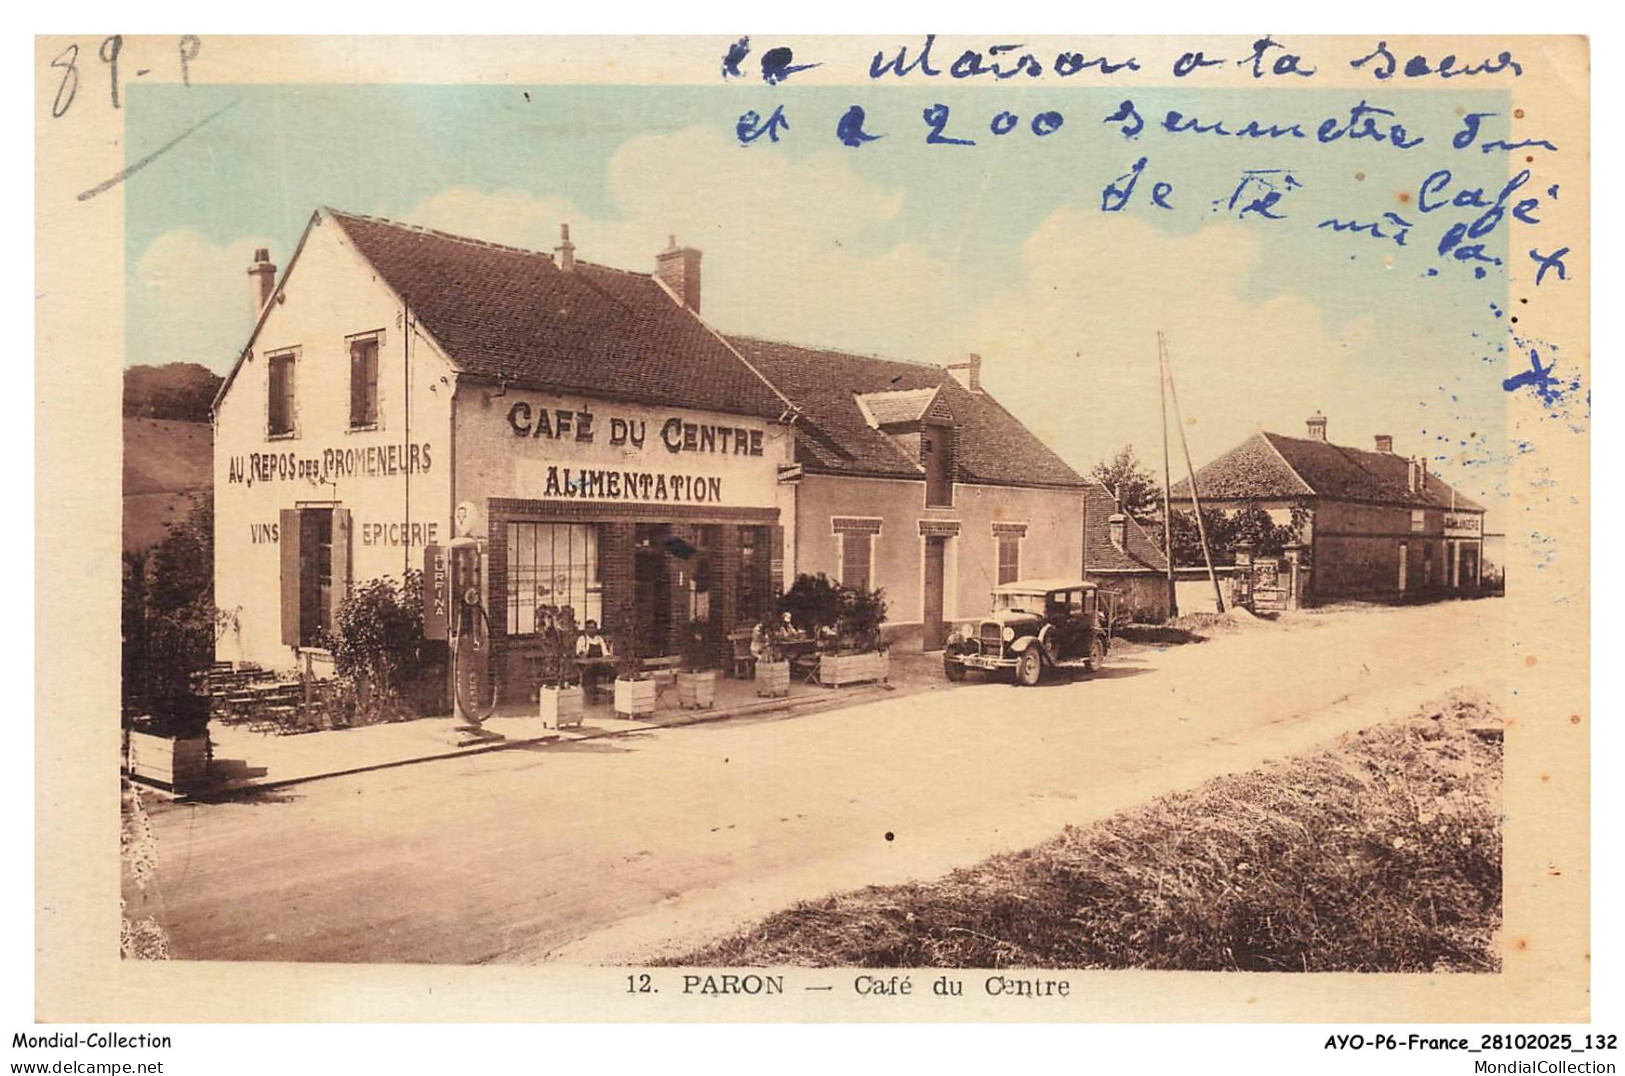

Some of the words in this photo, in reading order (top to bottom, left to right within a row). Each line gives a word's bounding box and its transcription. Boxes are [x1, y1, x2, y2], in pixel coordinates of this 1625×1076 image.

[609, 417, 646, 450] DU
[660, 418, 764, 457] CENTRE
[228, 455, 245, 484] AU
[246, 452, 296, 488] REPOS
[299, 460, 319, 479] DES
[319, 442, 432, 485] PROMENEURS
[543, 466, 722, 502] ALIMENTATION
[250, 523, 279, 545] VINS
[362, 522, 438, 546] EPICERIE
[625, 974, 659, 994] 12.
[682, 975, 785, 996] PARON
[854, 974, 912, 996] Café
[932, 974, 964, 996] du
[985, 974, 1071, 998] Centre
